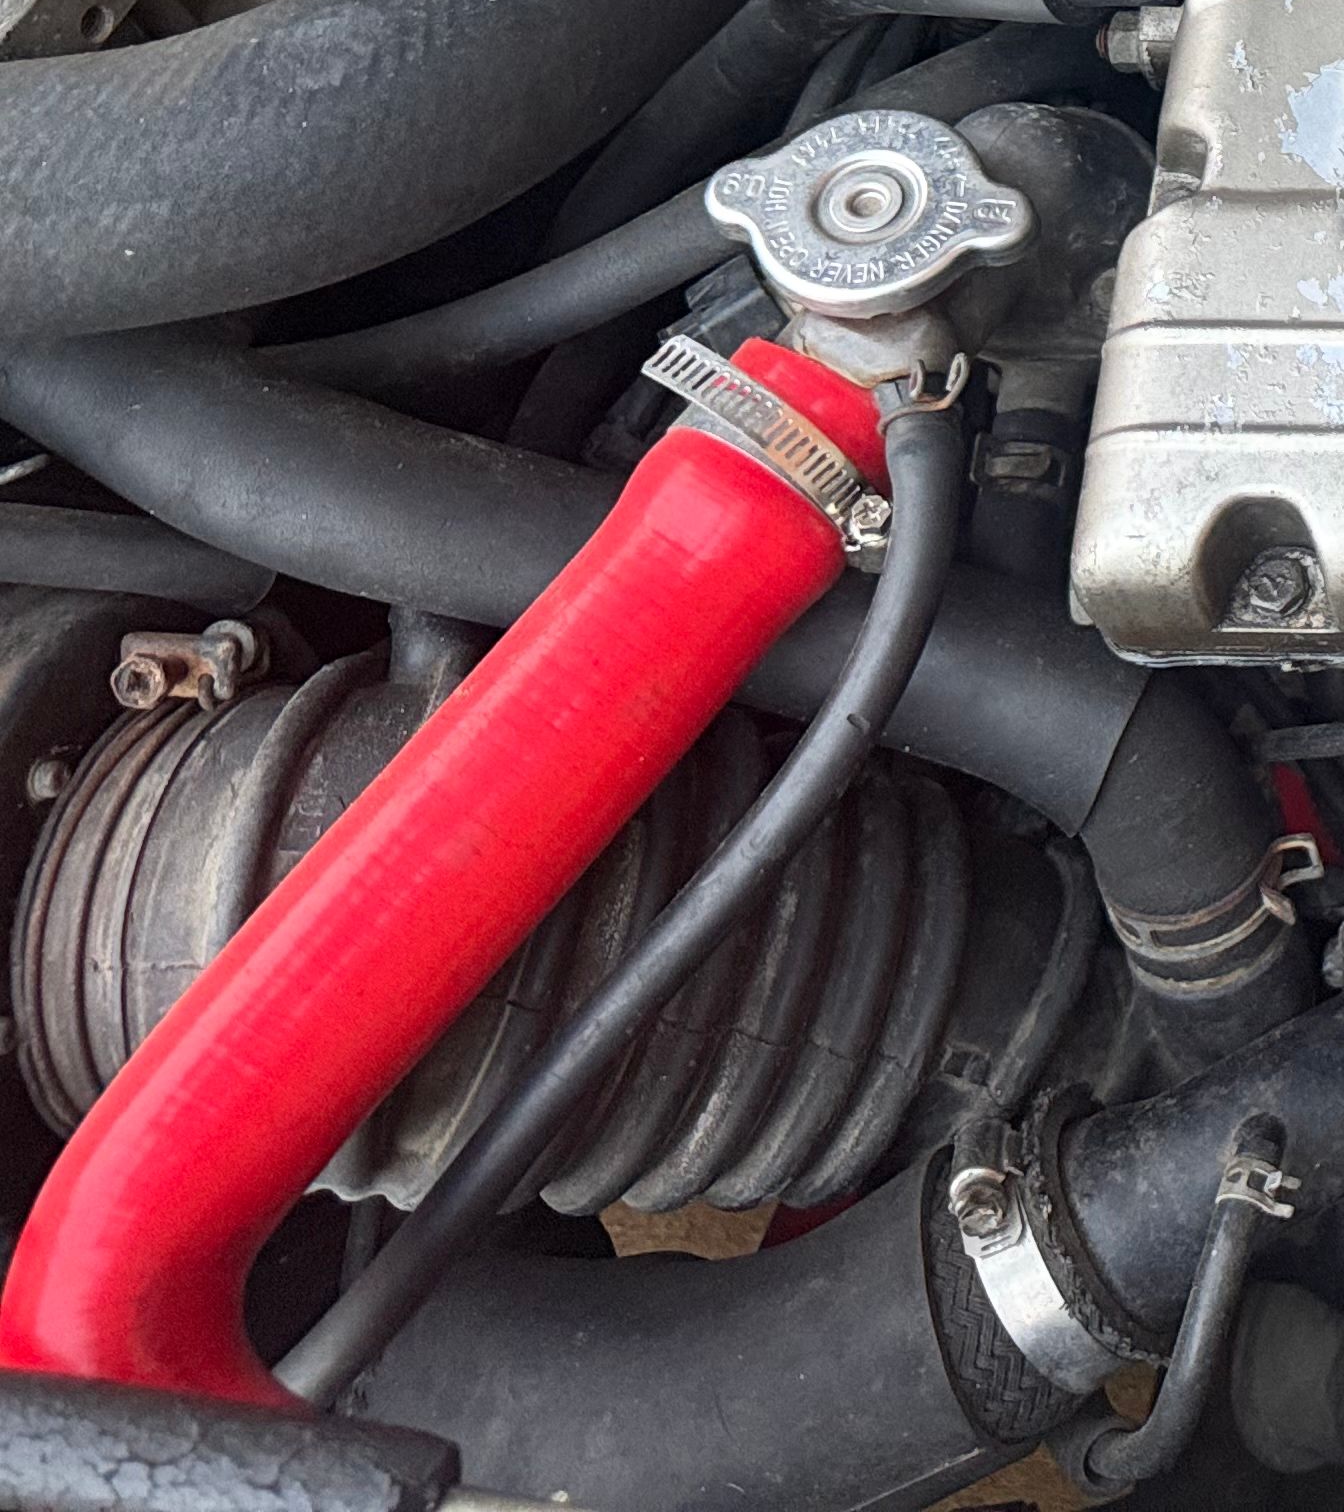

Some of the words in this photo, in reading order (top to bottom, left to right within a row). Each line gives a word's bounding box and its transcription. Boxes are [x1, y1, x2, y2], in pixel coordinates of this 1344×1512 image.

[764, 178, 793, 213] HOT
[766, 218, 809, 267] OPEN
[809, 258, 885, 284] NEVER
